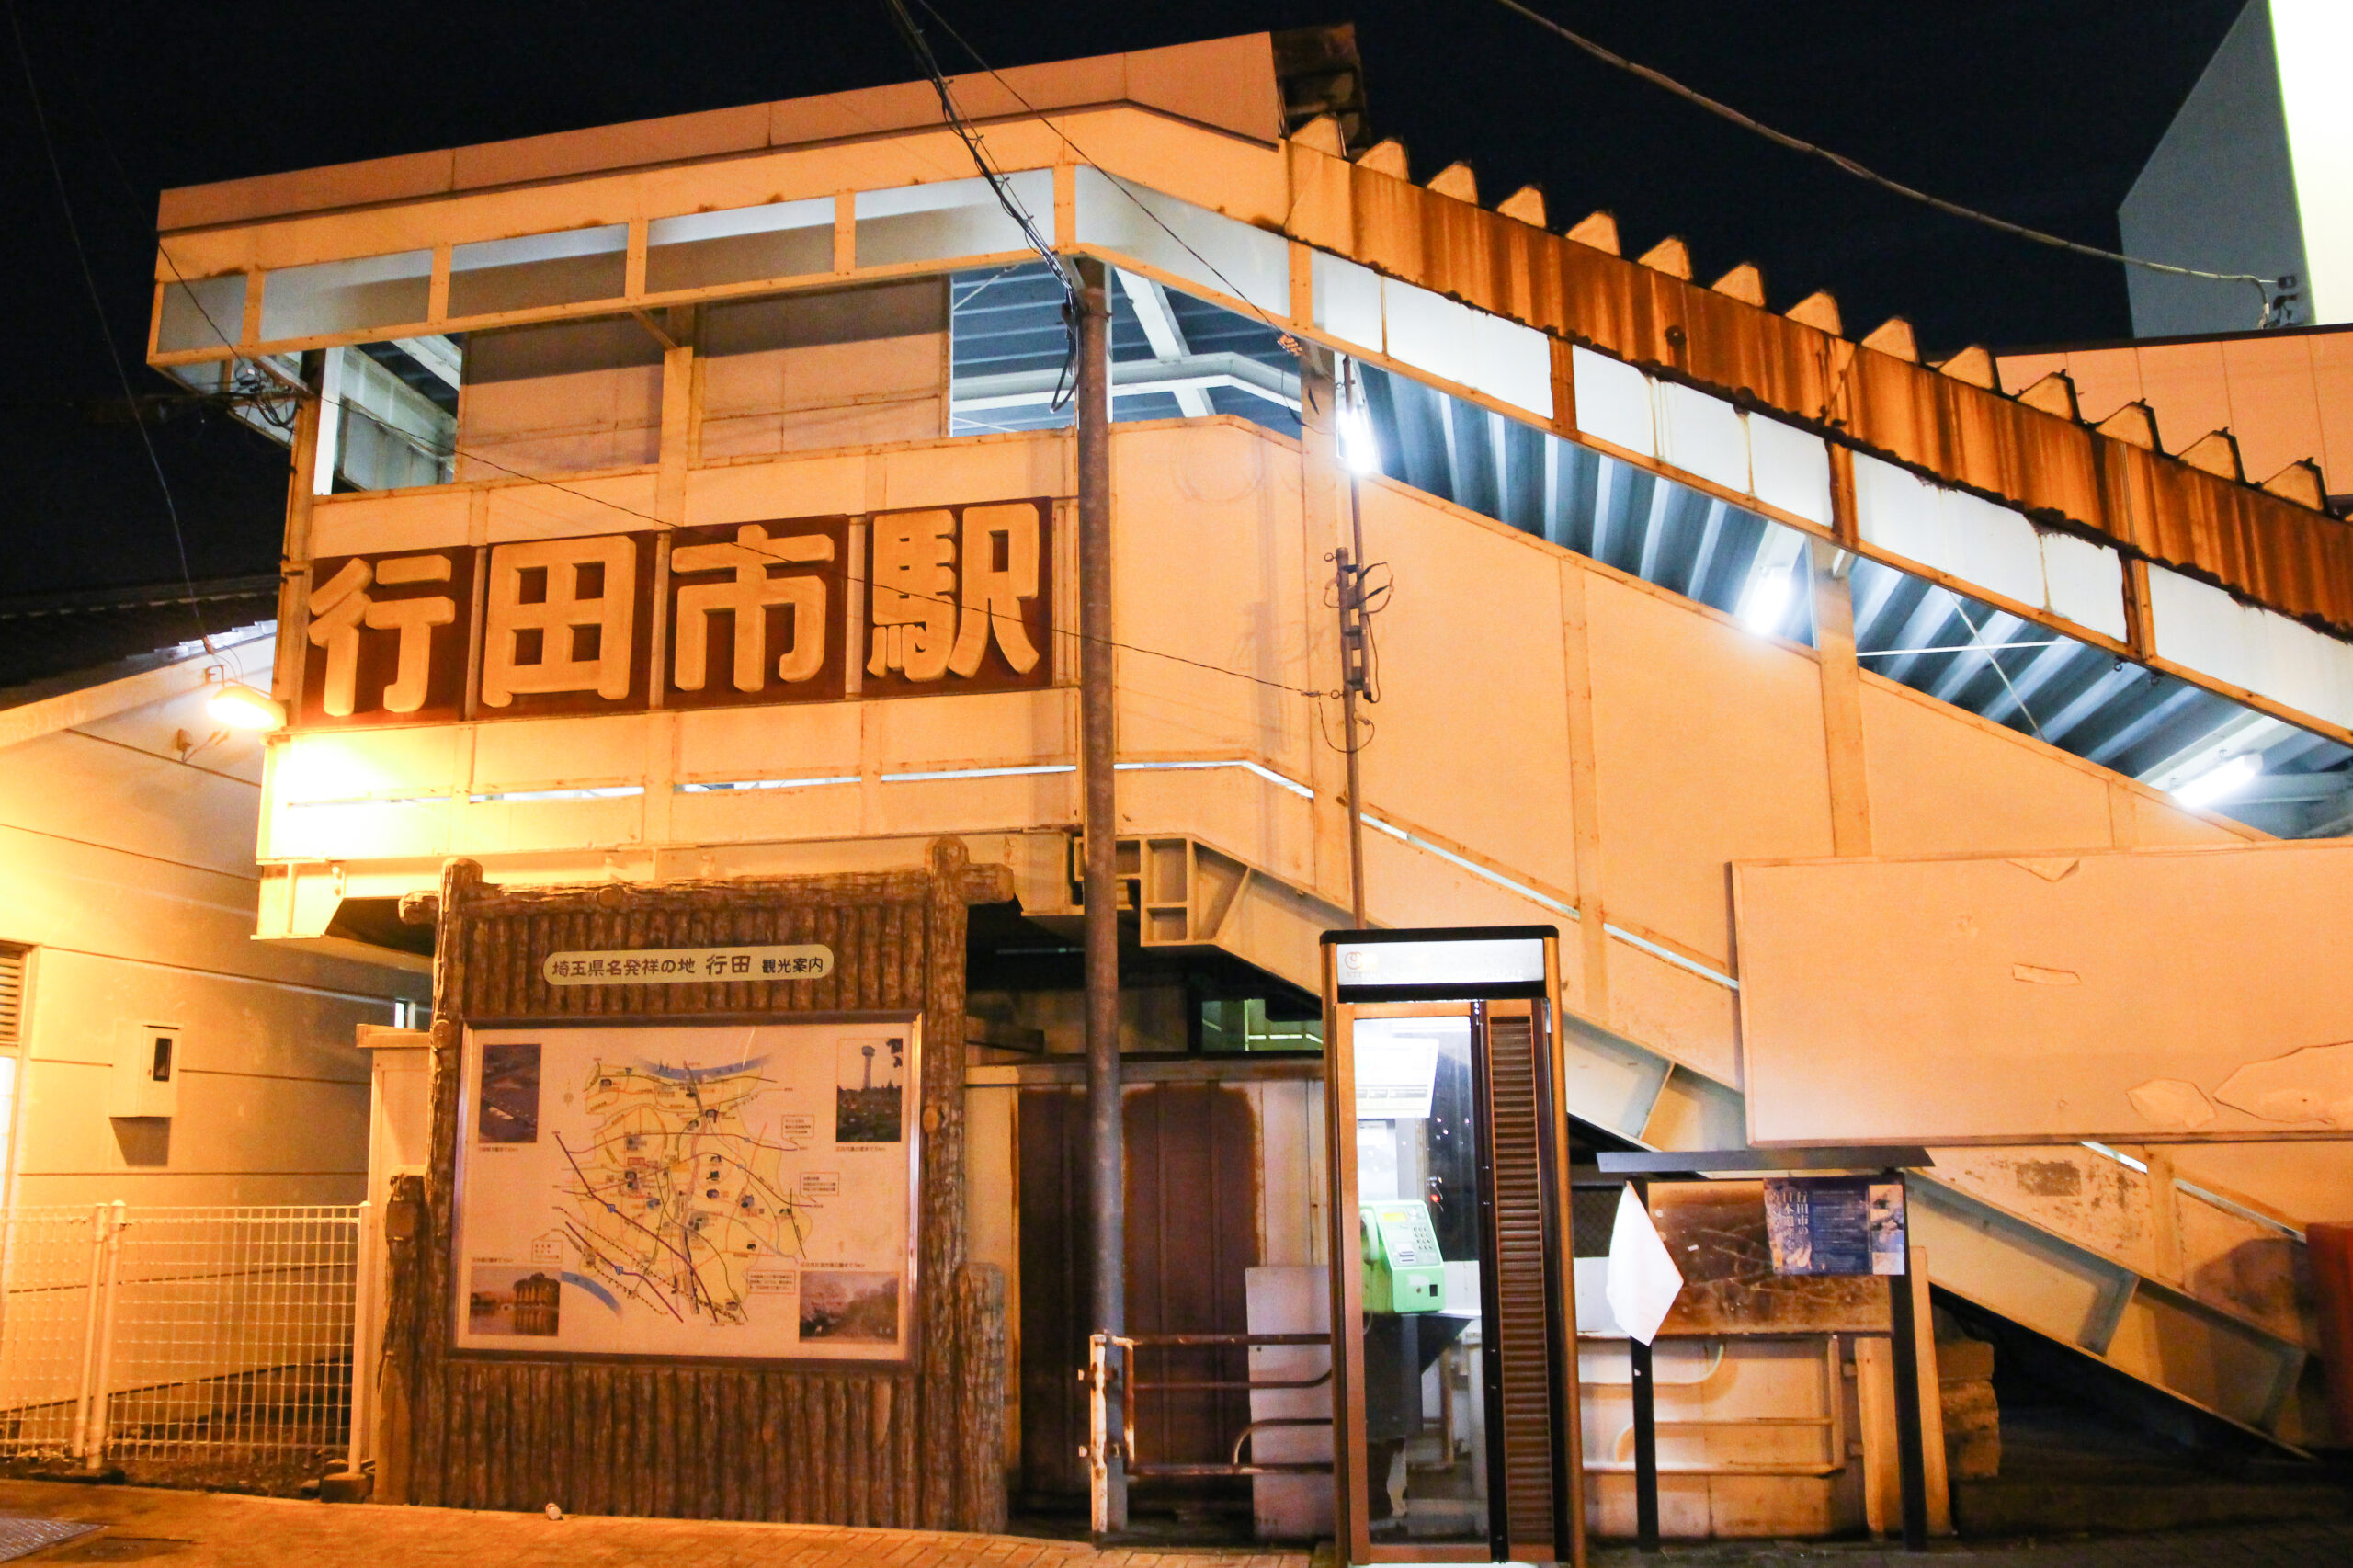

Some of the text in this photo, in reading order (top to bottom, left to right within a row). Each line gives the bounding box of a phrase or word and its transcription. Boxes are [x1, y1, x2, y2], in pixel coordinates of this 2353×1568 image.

[307, 502, 1040, 717] 行田市駅
[552, 954, 824, 977] 埼玉県名発祥の地 行田 観光案内
